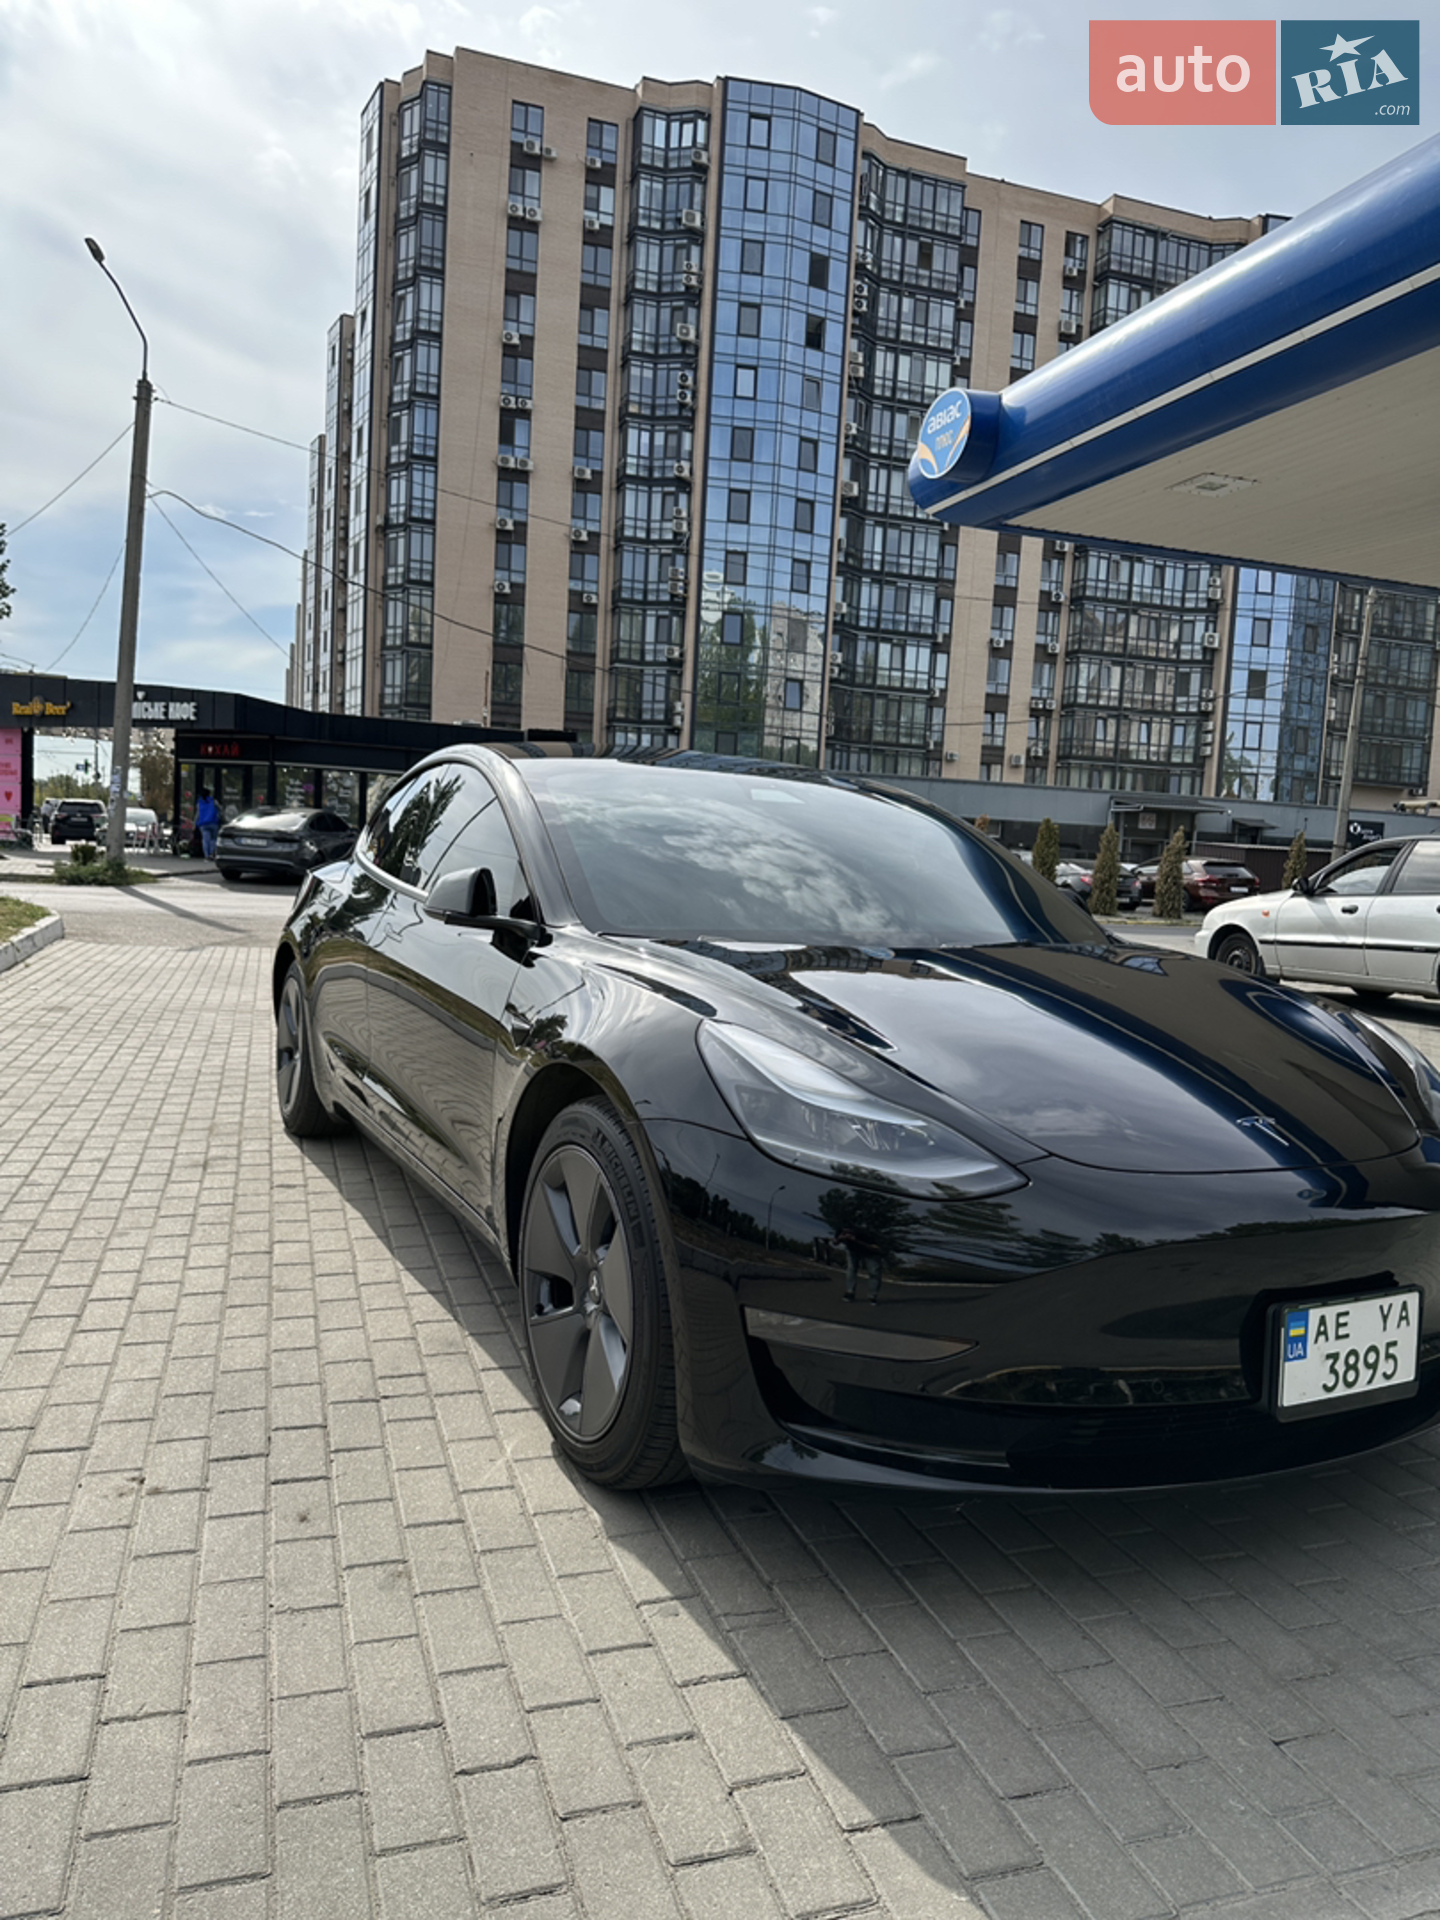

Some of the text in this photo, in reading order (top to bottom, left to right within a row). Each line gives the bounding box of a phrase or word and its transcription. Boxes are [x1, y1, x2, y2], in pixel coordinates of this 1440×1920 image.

[601, 1144, 640, 1221] MICHELIN
[1314, 1300, 1411, 1345] AE YA
[1287, 1343, 1305, 1360] UA
[1322, 1340, 1398, 1393] 3895
